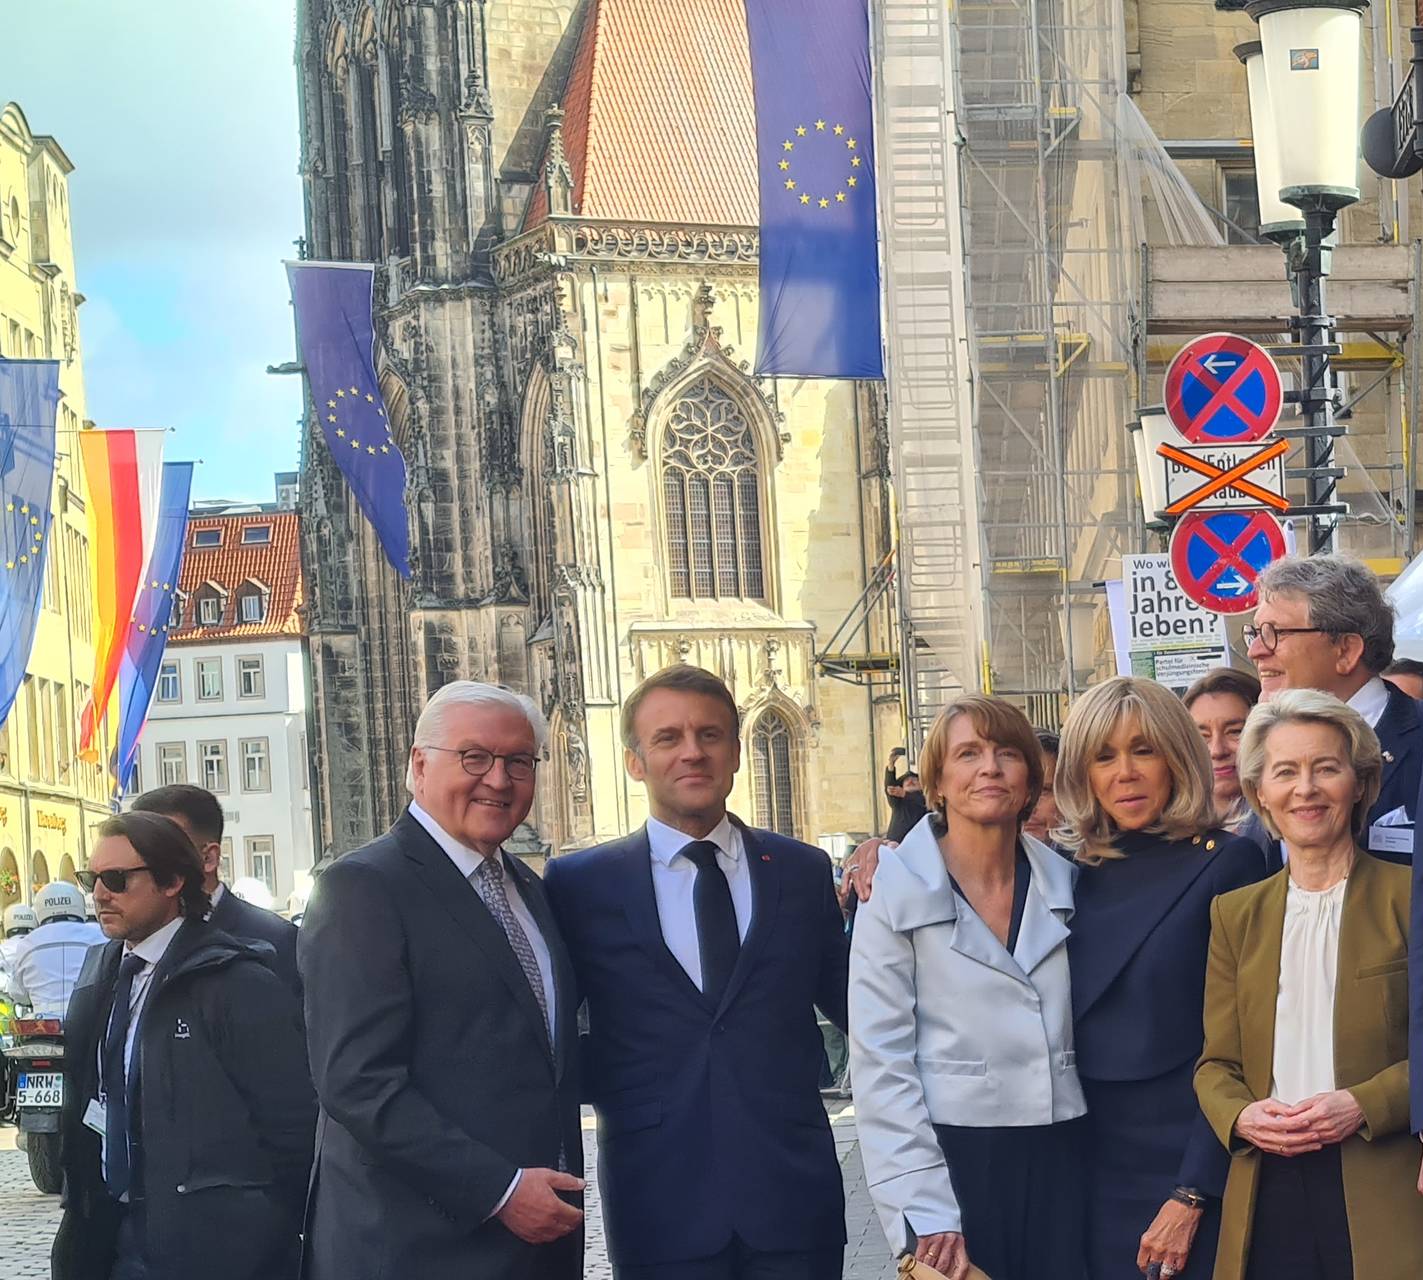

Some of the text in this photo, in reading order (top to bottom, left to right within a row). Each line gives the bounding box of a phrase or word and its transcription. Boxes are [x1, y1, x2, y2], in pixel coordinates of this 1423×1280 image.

[1133, 560, 1153, 569] Wo
[1132, 571, 1155, 592] in
[1131, 611, 1218, 638] leben?
[44, 896, 72, 907] POLIZEI
[26, 1075, 54, 1089] NRW
